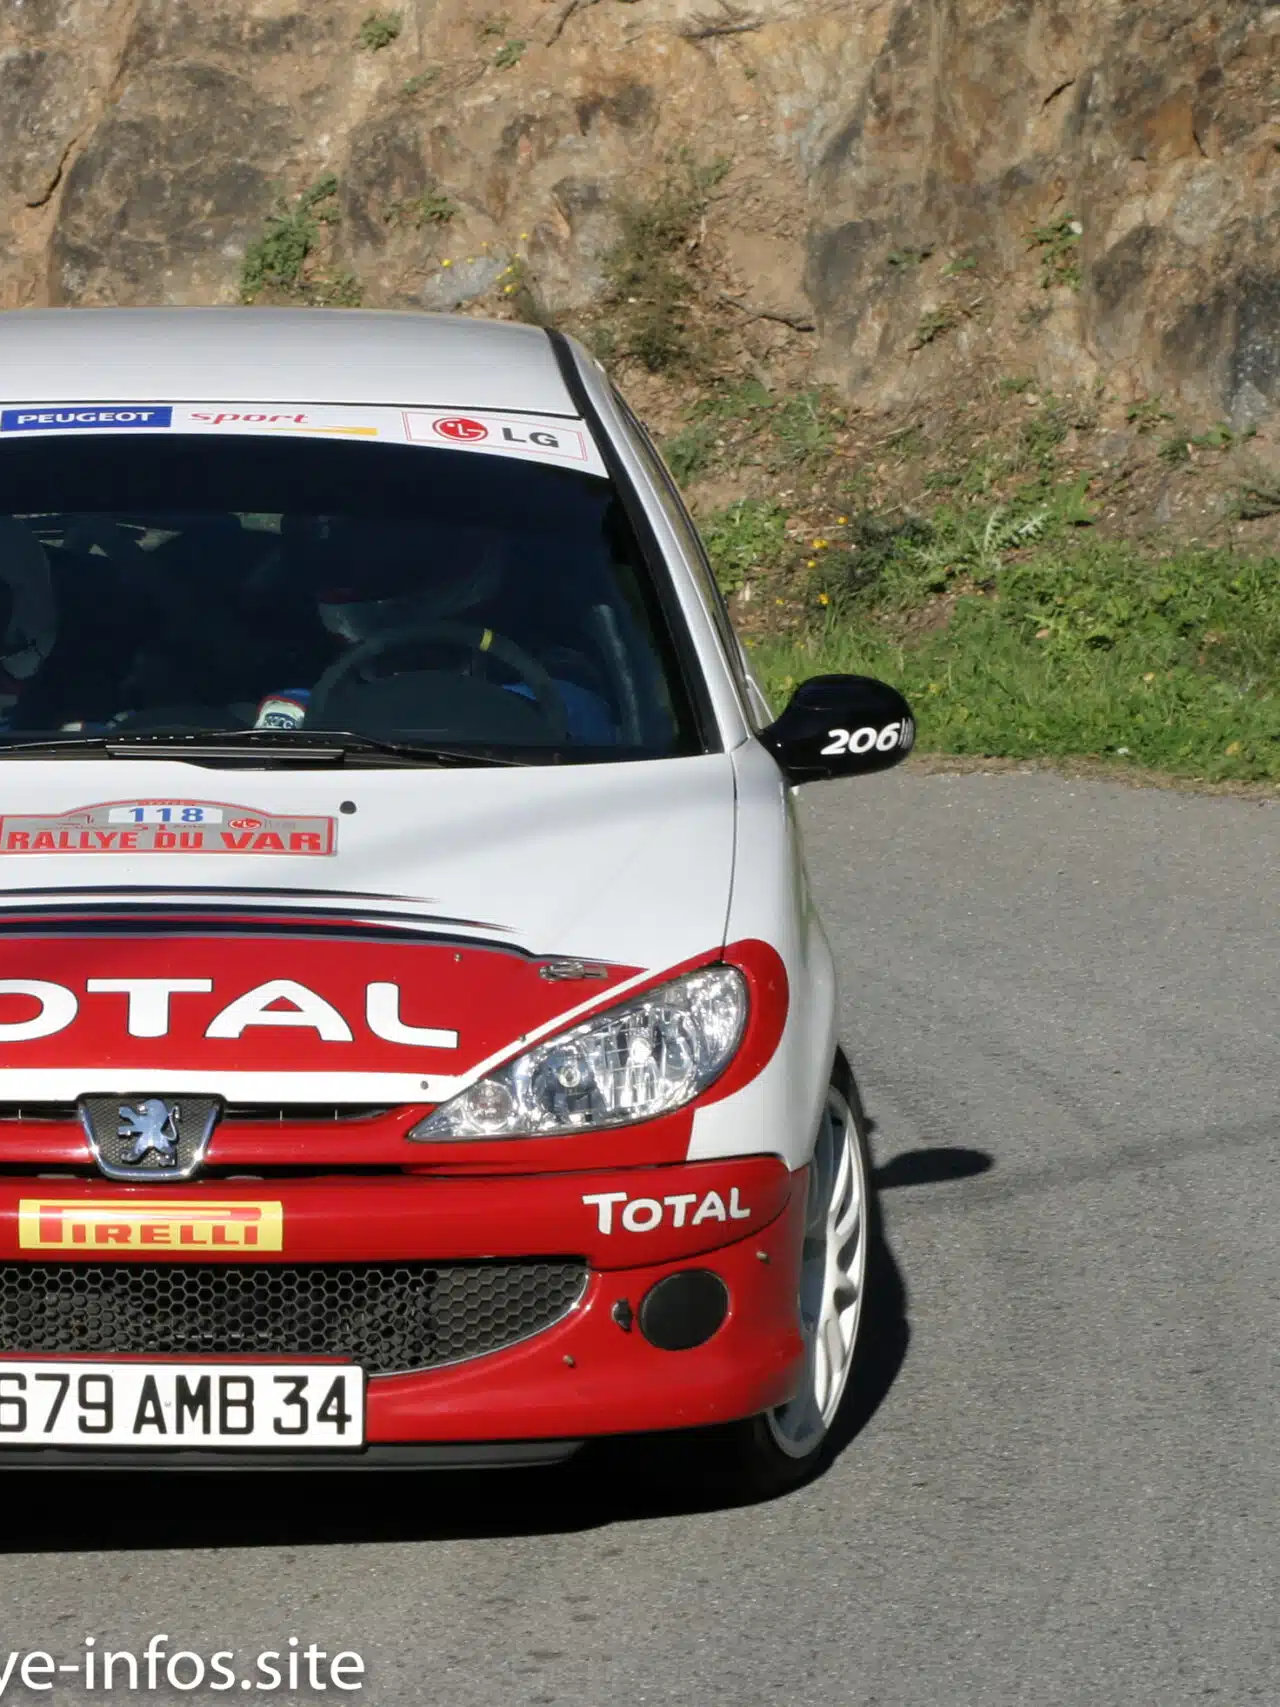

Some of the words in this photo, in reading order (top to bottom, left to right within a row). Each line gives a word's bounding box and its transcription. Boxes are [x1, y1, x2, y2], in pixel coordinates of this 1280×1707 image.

[17, 411, 155, 424] PEUGEOT
[190, 411, 309, 425] sport
[503, 427, 559, 448] LG
[820, 722, 901, 755] 206
[129, 807, 204, 822] 118
[6, 831, 138, 849] RALLYE
[154, 831, 204, 849] DU
[220, 831, 321, 850] VAR
[582, 1187, 751, 1235] TOTAL
[39, 1204, 263, 1245] PIRELLI
[133, 1374, 255, 1435] AMB
[273, 1375, 353, 1436] 34
